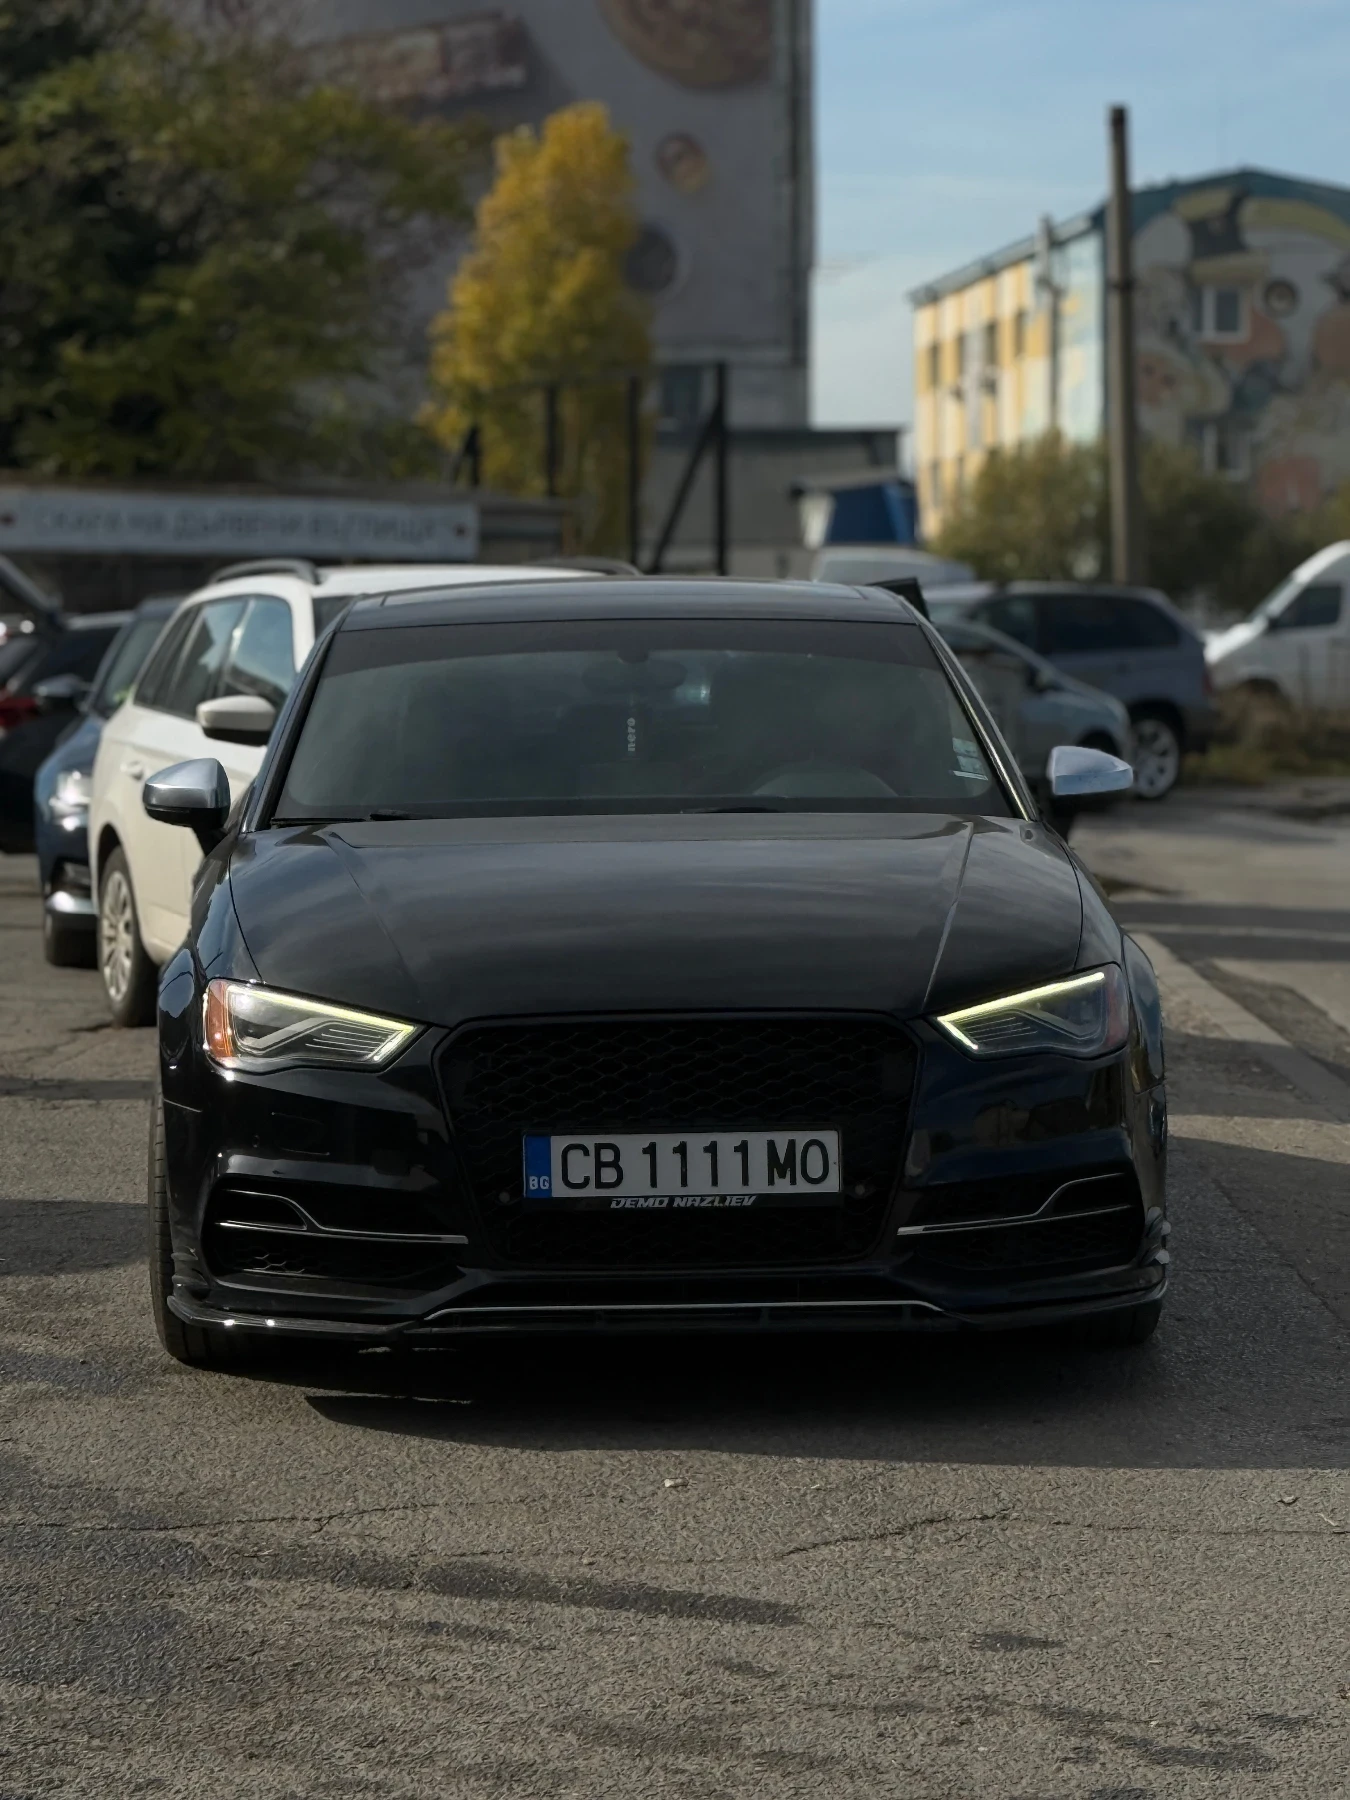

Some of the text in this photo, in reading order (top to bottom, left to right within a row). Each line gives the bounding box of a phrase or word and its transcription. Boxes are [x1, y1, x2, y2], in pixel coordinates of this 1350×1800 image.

[560, 1138, 830, 1189] CB 1111 MO
[529, 1175, 550, 1190] BG
[673, 1195, 757, 1208] NAZLIEV
